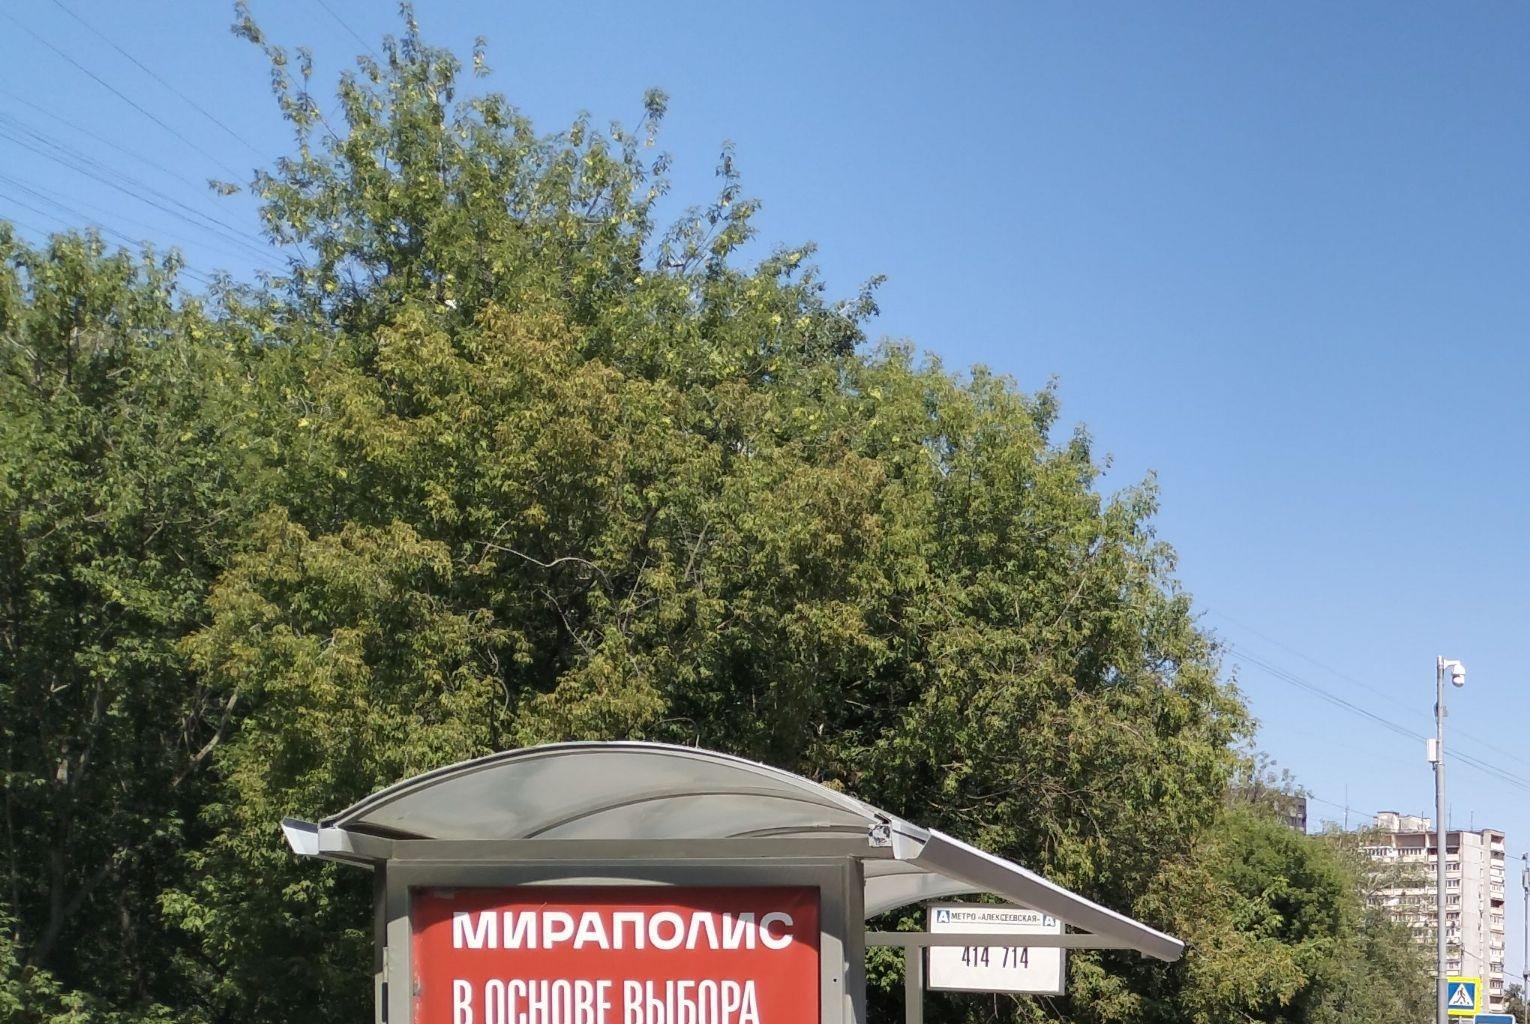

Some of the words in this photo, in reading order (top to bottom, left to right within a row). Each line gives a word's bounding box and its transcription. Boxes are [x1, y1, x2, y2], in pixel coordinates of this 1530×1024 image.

[951, 911, 976, 921] МЕТРО
[452, 911, 794, 950] МИРАПОЛИС
[961, 946, 990, 968] 414
[1002, 946, 1029, 969] 714
